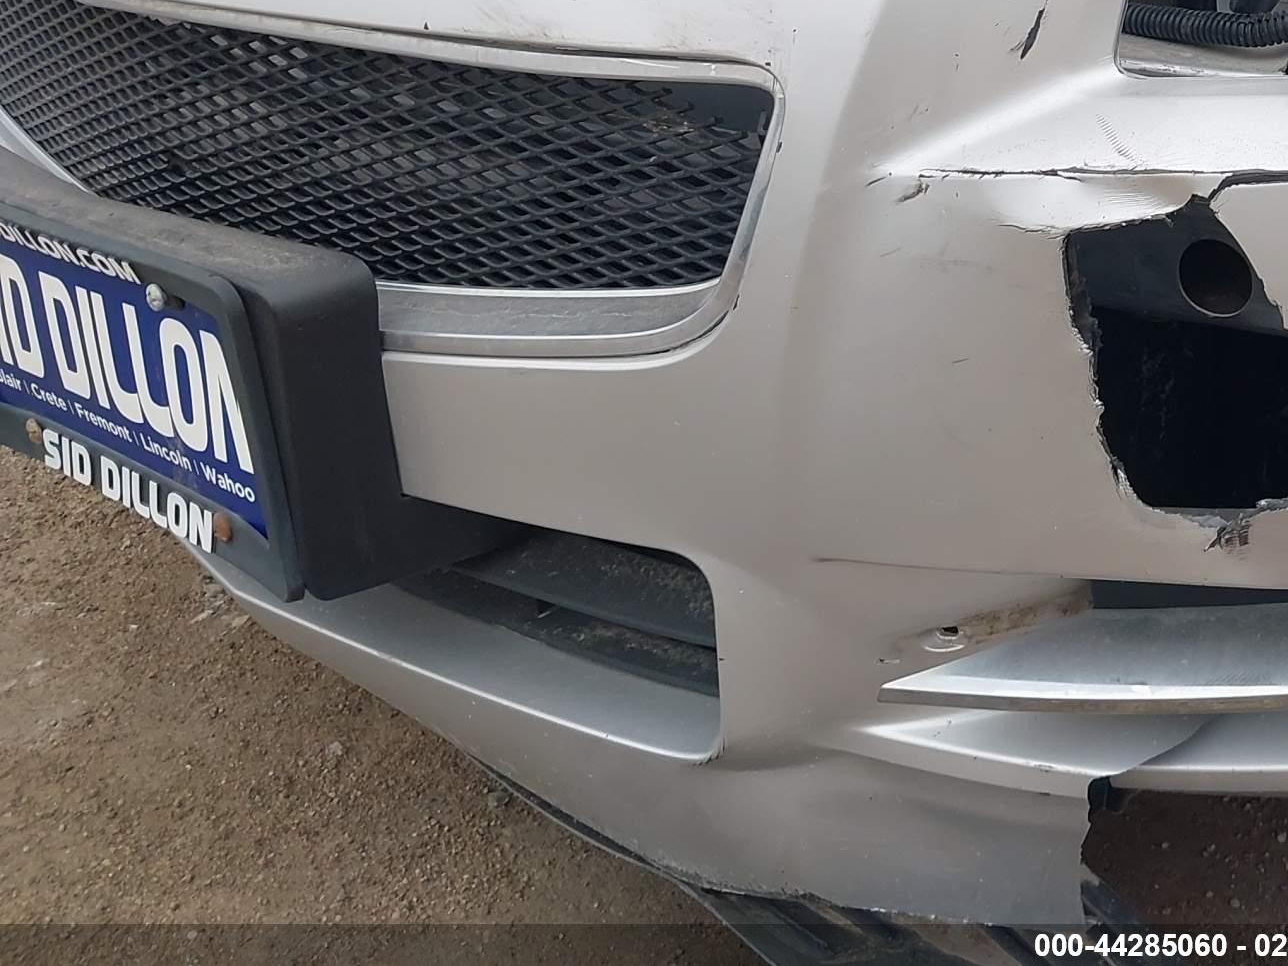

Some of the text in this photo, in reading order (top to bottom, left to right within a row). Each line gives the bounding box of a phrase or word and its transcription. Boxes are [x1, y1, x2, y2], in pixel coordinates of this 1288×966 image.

[38, 270, 254, 475] DILLON
[30, 382, 68, 412] Crete
[73, 401, 133, 443] Fremont
[139, 432, 193, 472] Lincoln
[199, 461, 256, 503] Wahoo
[42, 428, 213, 554] SID DILLON
